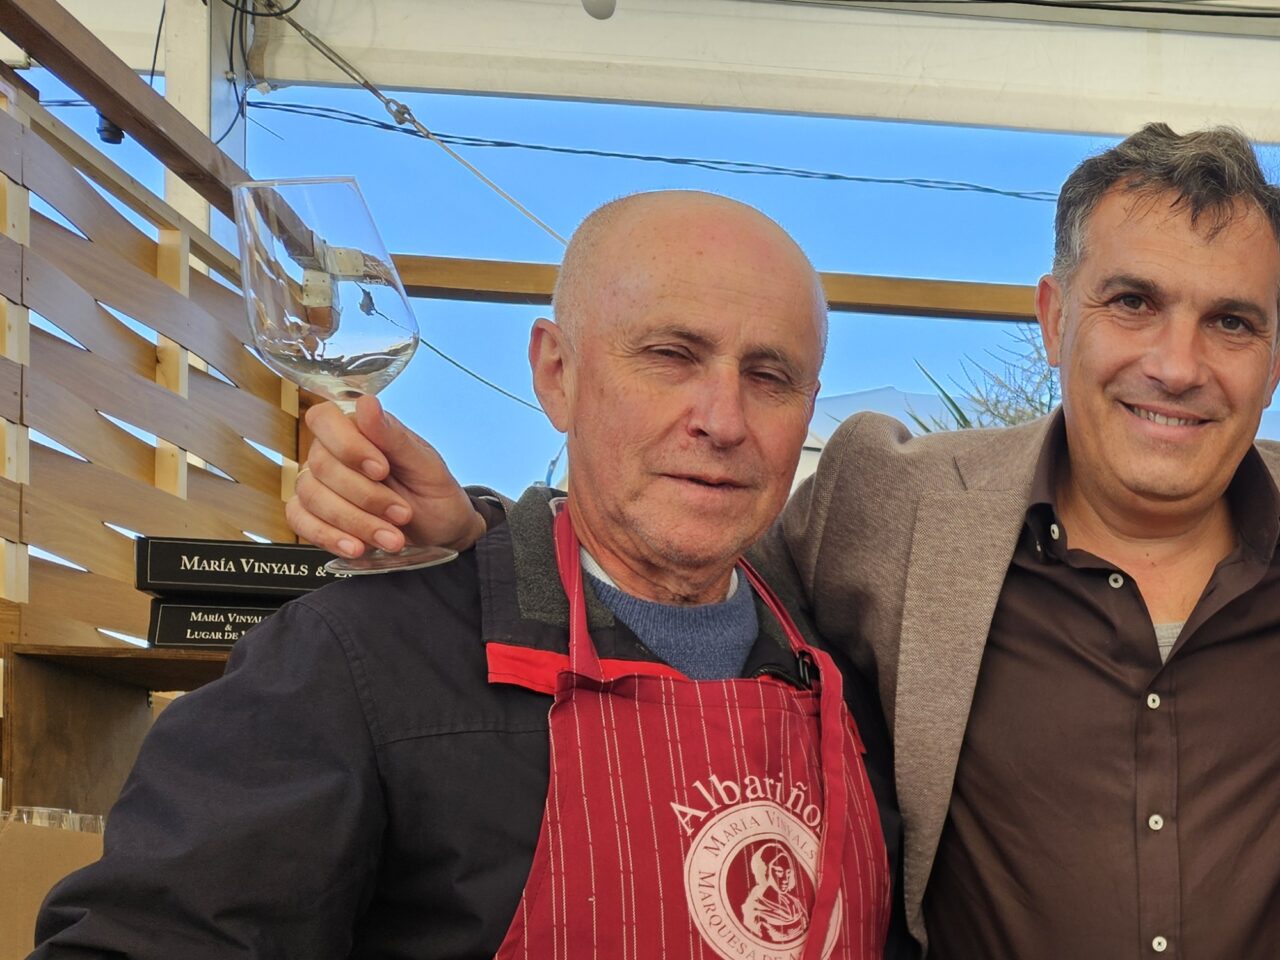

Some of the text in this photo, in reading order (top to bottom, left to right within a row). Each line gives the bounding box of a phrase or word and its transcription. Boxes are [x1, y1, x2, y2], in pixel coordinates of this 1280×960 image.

[180, 554, 236, 573] MARÍA
[239, 557, 309, 577] VINYALS
[315, 565, 327, 577] &
[190, 611, 225, 622] MARÍA
[186, 628, 222, 640] LUGAR
[224, 631, 239, 640] DE
[224, 623, 233, 631] &
[670, 772, 824, 836] Albariño
[765, 810, 814, 859] VINYALS
